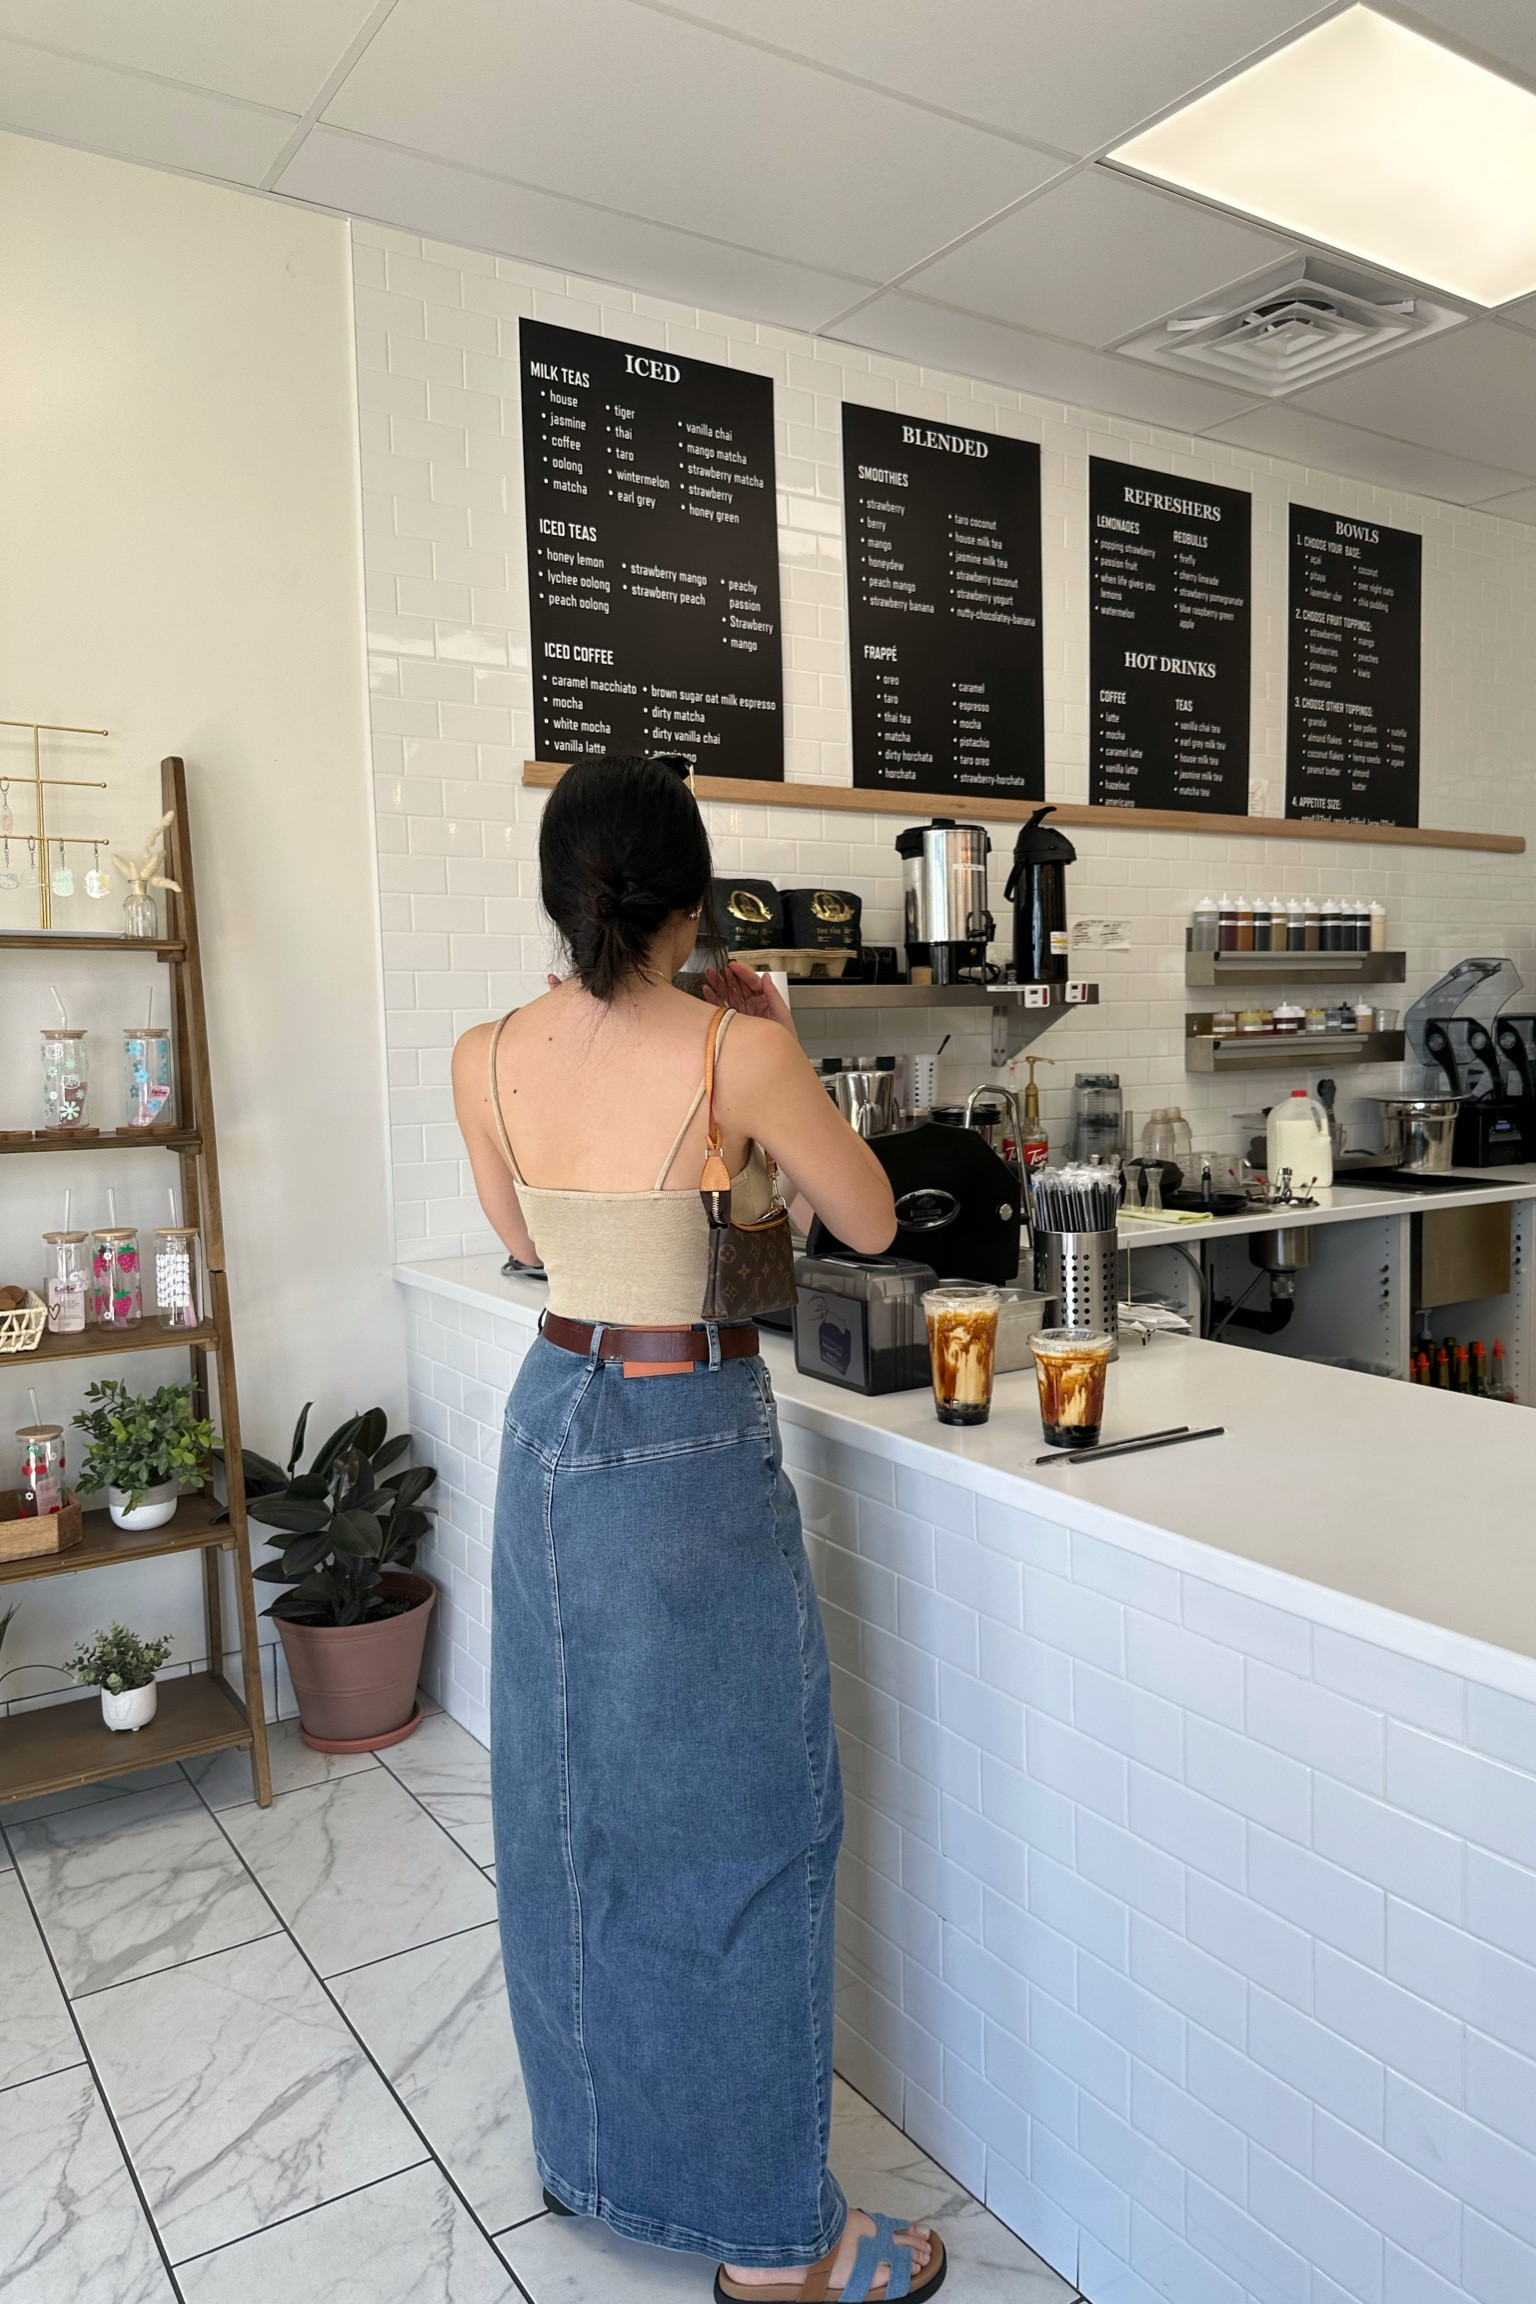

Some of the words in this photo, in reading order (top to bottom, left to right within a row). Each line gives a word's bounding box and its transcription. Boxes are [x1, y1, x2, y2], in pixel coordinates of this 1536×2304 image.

[530, 360, 559, 381] MILK
[560, 367, 590, 388] TEAS
[624, 354, 680, 383] ICED
[549, 389, 578, 407] house
[549, 411, 586, 431] jasmine
[613, 404, 635, 420] tiger
[614, 425, 632, 440] thai
[685, 423, 713, 437] vanilla
[714, 427, 733, 441] chai
[551, 435, 581, 451] coffee
[901, 425, 988, 458] BLENDED
[615, 447, 634, 461] taro
[686, 444, 715, 459] mango
[716, 450, 747, 465] matcha
[552, 456, 583, 475] oolong
[616, 469, 670, 489] wintermelon
[687, 463, 732, 484] strawberry
[733, 474, 764, 488] matcha
[858, 465, 909, 487] SMOOTHIES
[552, 480, 588, 495] matcha
[688, 484, 733, 504] strawberry
[617, 491, 635, 503] earl
[636, 495, 656, 509] grey
[866, 499, 905, 516] strawberry
[1123, 486, 1221, 522] REFRESHERS
[688, 502, 714, 521] honey
[715, 511, 739, 524] green
[954, 513, 969, 526] taro
[969, 518, 997, 530] coconut
[539, 518, 565, 537] ICED
[567, 522, 597, 542] TEAS
[866, 516, 886, 532] berry
[1096, 514, 1140, 535] LEMONADES
[1335, 520, 1379, 544] BOWLS
[867, 538, 892, 552] mango
[954, 531, 976, 545] house
[976, 536, 990, 547] milk
[991, 538, 1002, 550] tea
[1173, 530, 1208, 548] REDBULLS
[546, 547, 575, 566] honey
[576, 552, 604, 568] lemon
[868, 555, 904, 571] honeydew
[954, 550, 981, 565] jasmine
[982, 555, 996, 567] milk
[996, 557, 1008, 569] tea
[547, 569, 578, 586] lychee
[580, 575, 610, 593] oolong
[630, 563, 677, 582] strawberry
[678, 572, 707, 587] mango
[955, 570, 991, 586] strawberry
[992, 576, 1018, 588] coconut
[631, 584, 678, 603] strawberry
[679, 593, 706, 605] peach
[728, 580, 758, 595] peachy
[868, 577, 891, 588] peach
[892, 580, 916, 594] mango
[548, 594, 577, 607] peach
[579, 597, 609, 614] oolong
[729, 598, 761, 612] passion
[869, 595, 908, 612] strawberry
[908, 599, 935, 614] banana
[956, 588, 992, 604] strawberry
[992, 595, 1013, 607] yogurt
[729, 614, 773, 635] Strawberry
[544, 642, 570, 660] ICED
[573, 645, 614, 665] COFFEE
[730, 638, 758, 652] mango
[864, 644, 897, 662] FRAPPÉ
[1124, 651, 1158, 670] HOT
[1159, 656, 1216, 678] DRINKS
[551, 675, 588, 689] caramel
[590, 679, 637, 695] macchiato
[882, 675, 899, 685] oreo
[958, 683, 985, 694] caramel
[552, 696, 583, 710] mocha
[650, 684, 678, 699] brown
[679, 690, 703, 704] sugar
[705, 693, 719, 704] oat
[720, 693, 738, 706] milk
[739, 697, 776, 711] espresso
[883, 693, 899, 704] taro
[1099, 689, 1126, 704] COFFEE
[1175, 698, 1193, 712] TEAS
[651, 705, 672, 721] dirty
[673, 710, 705, 723] matcha
[958, 701, 989, 712] espresso
[552, 716, 579, 731] white
[580, 720, 611, 734] mocha
[883, 711, 898, 723] thai
[898, 713, 911, 724] tea
[959, 718, 982, 730] mocha
[652, 726, 672, 742] dirty
[673, 730, 701, 743] vanilla
[702, 731, 720, 745] chai
[884, 731, 911, 743] matcha
[959, 736, 990, 748] pistachio
[553, 739, 584, 752] vanilla
[585, 740, 606, 754] latte
[884, 748, 901, 762] dirty
[902, 749, 933, 763] horchata
[959, 755, 974, 765] taro
[974, 757, 990, 766] oreo
[884, 767, 916, 780] horchata
